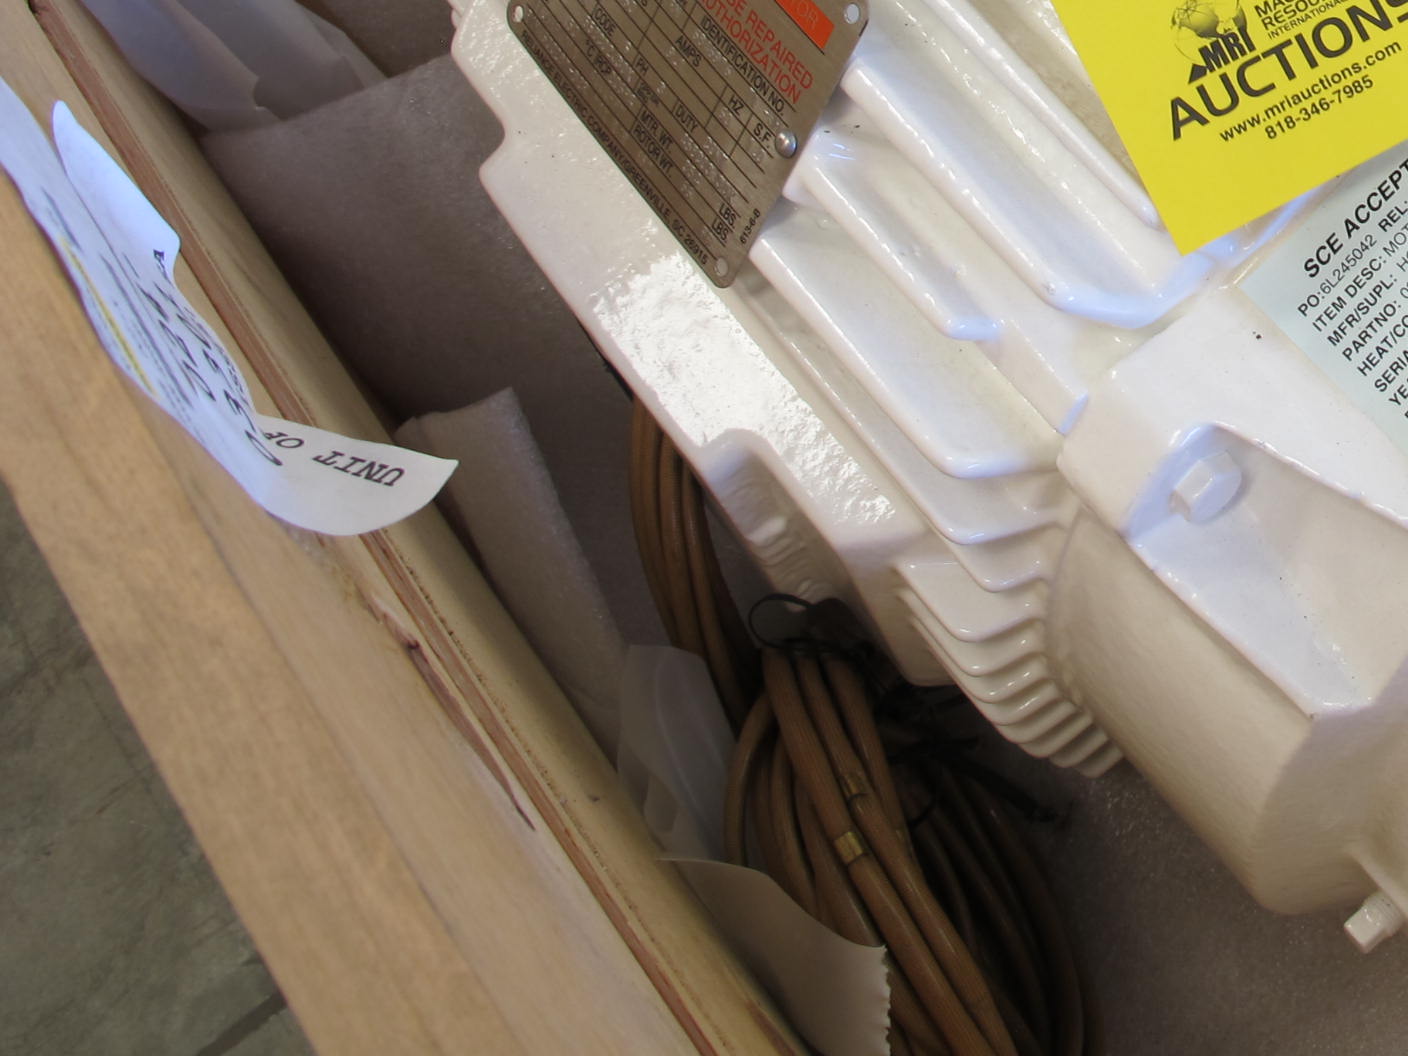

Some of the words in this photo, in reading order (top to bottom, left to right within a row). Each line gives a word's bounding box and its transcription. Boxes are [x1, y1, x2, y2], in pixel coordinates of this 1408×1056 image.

[594, 7, 615, 36] CODE
[636, 57, 648, 76] PH
[675, 104, 697, 134] DUTY
[675, 33, 701, 67] AMPS
[729, 94, 742, 114] HZ
[701, 14, 768, 97] IDENTIFICATION
[768, 91, 786, 116] NO.
[745, 8, 814, 93] REPAIRED
[1198, 25, 1257, 73] MRI
[1220, 41, 1402, 142] www.mriauctions.com
[1265, 75, 1373, 140] 818-346-7985
[1304, 233, 1343, 278] SCE
[1312, 296, 1348, 333] ITEM
[1344, 256, 1387, 298] DESC:
[1326, 274, 1397, 347] MFR/SUPL:
[1342, 300, 1402, 362] PARTNO:
[262, 431, 306, 449] OF
[312, 450, 404, 486] UNIT
